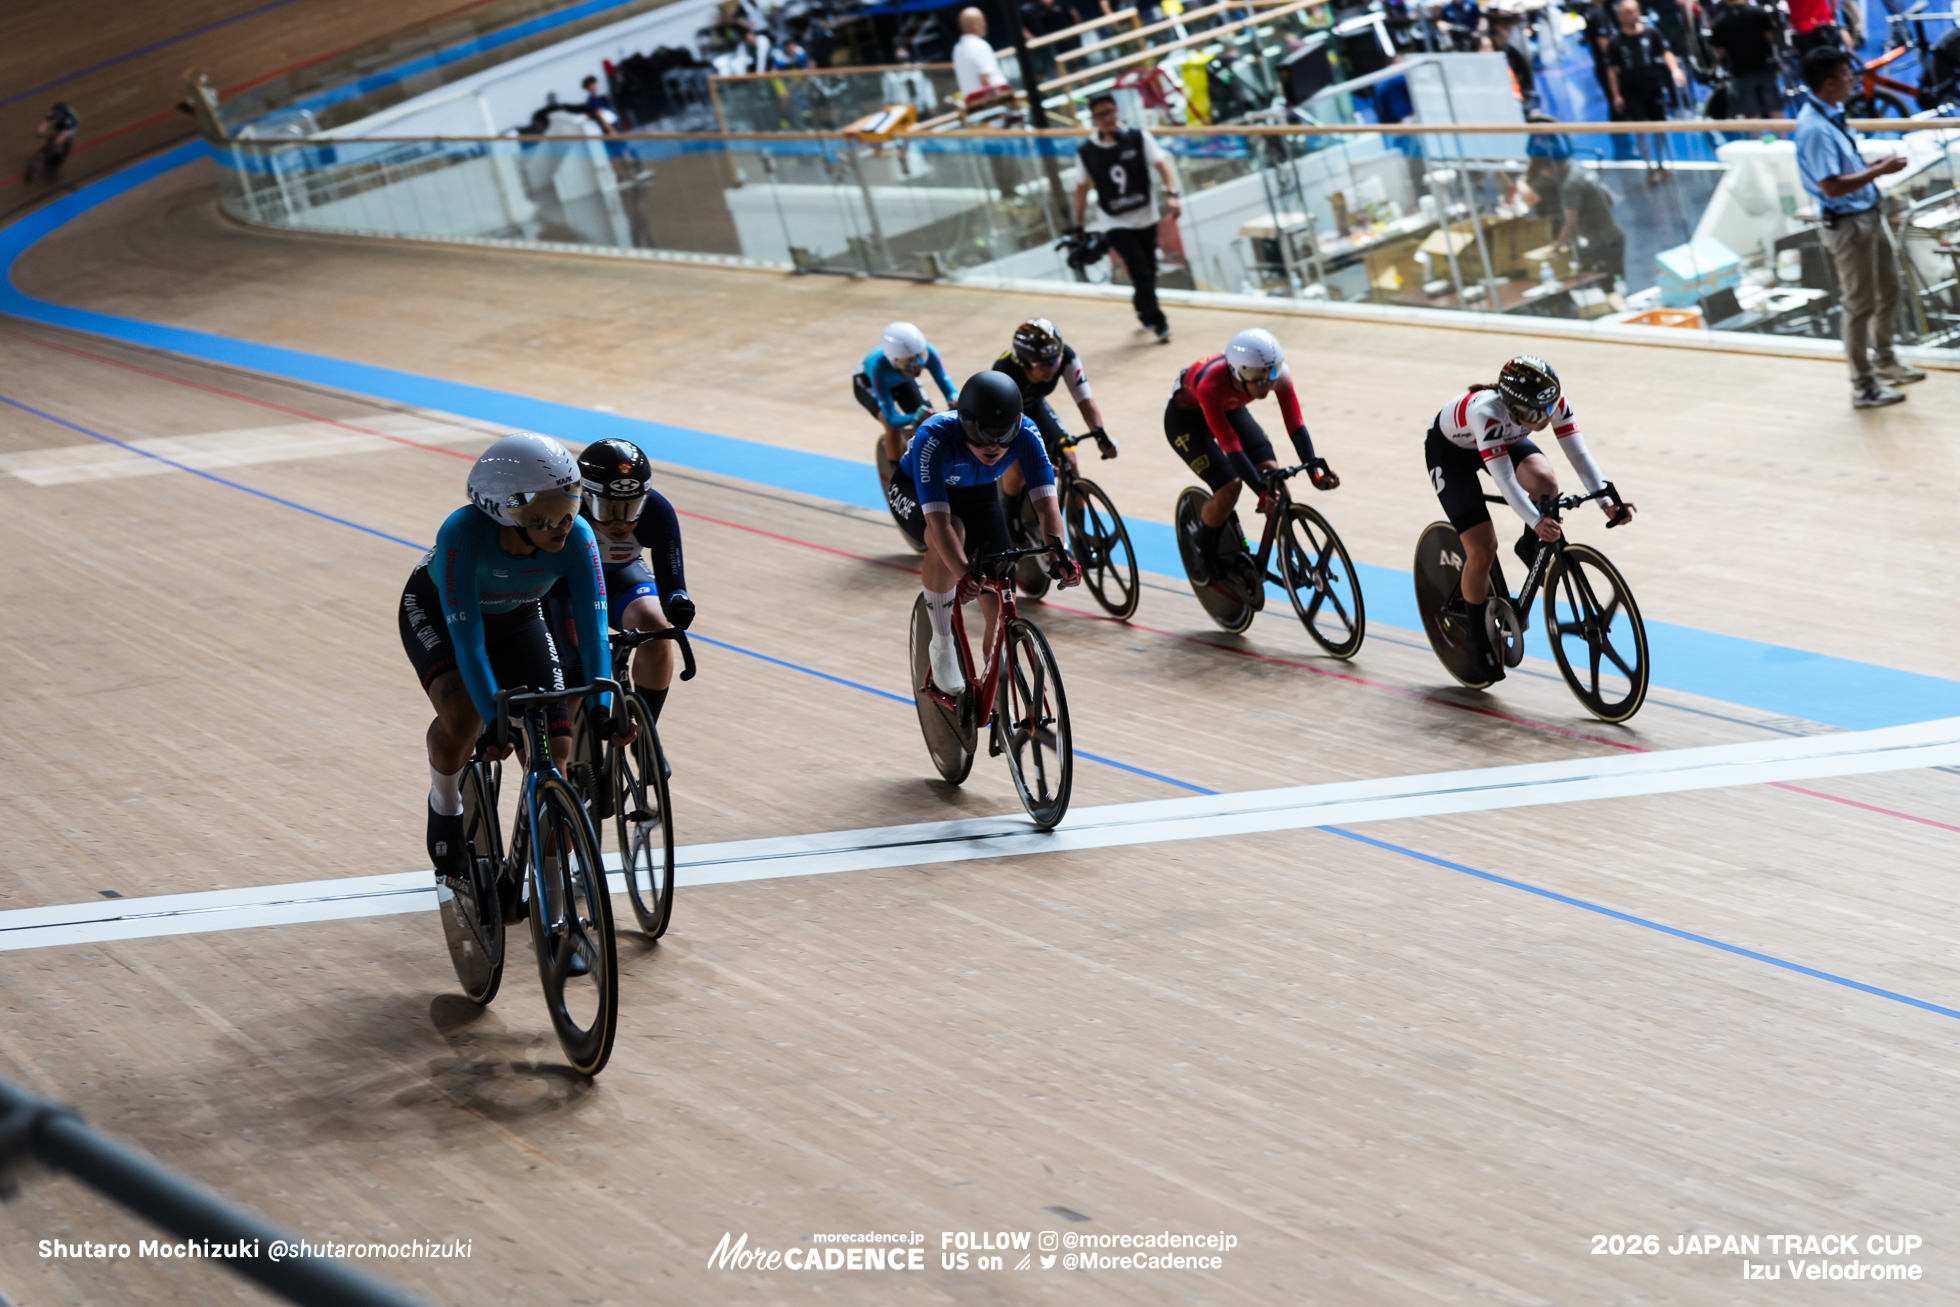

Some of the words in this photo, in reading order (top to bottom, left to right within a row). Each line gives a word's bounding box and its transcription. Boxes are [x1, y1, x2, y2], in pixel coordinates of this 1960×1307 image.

[1108, 164, 1128, 196] 9
[919, 435, 941, 484] SHIMANO
[480, 587, 544, 600] bossini.X
[594, 600, 608, 610] HK
